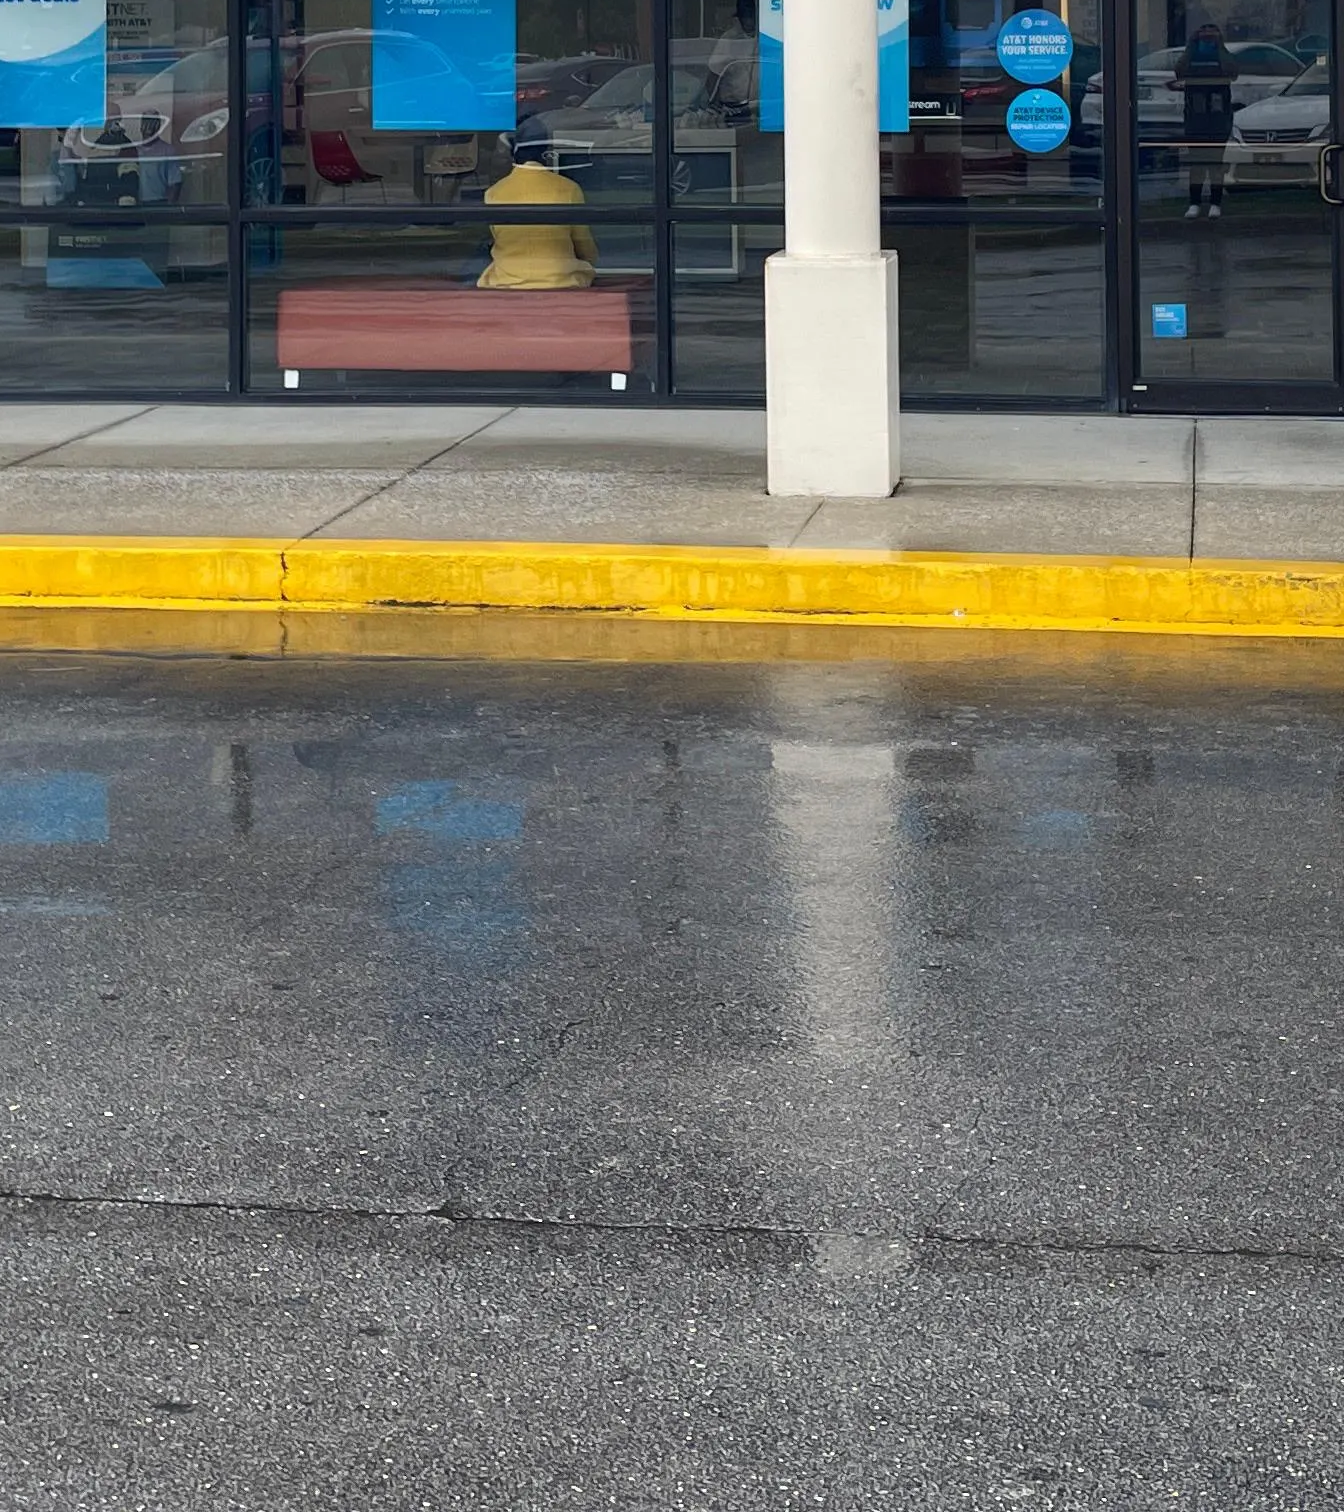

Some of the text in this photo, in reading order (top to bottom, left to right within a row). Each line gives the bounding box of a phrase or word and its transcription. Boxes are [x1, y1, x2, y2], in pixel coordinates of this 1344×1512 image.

[1003, 34, 1067, 44] AT&T HONORS
[1002, 45, 1027, 55] YOUR
